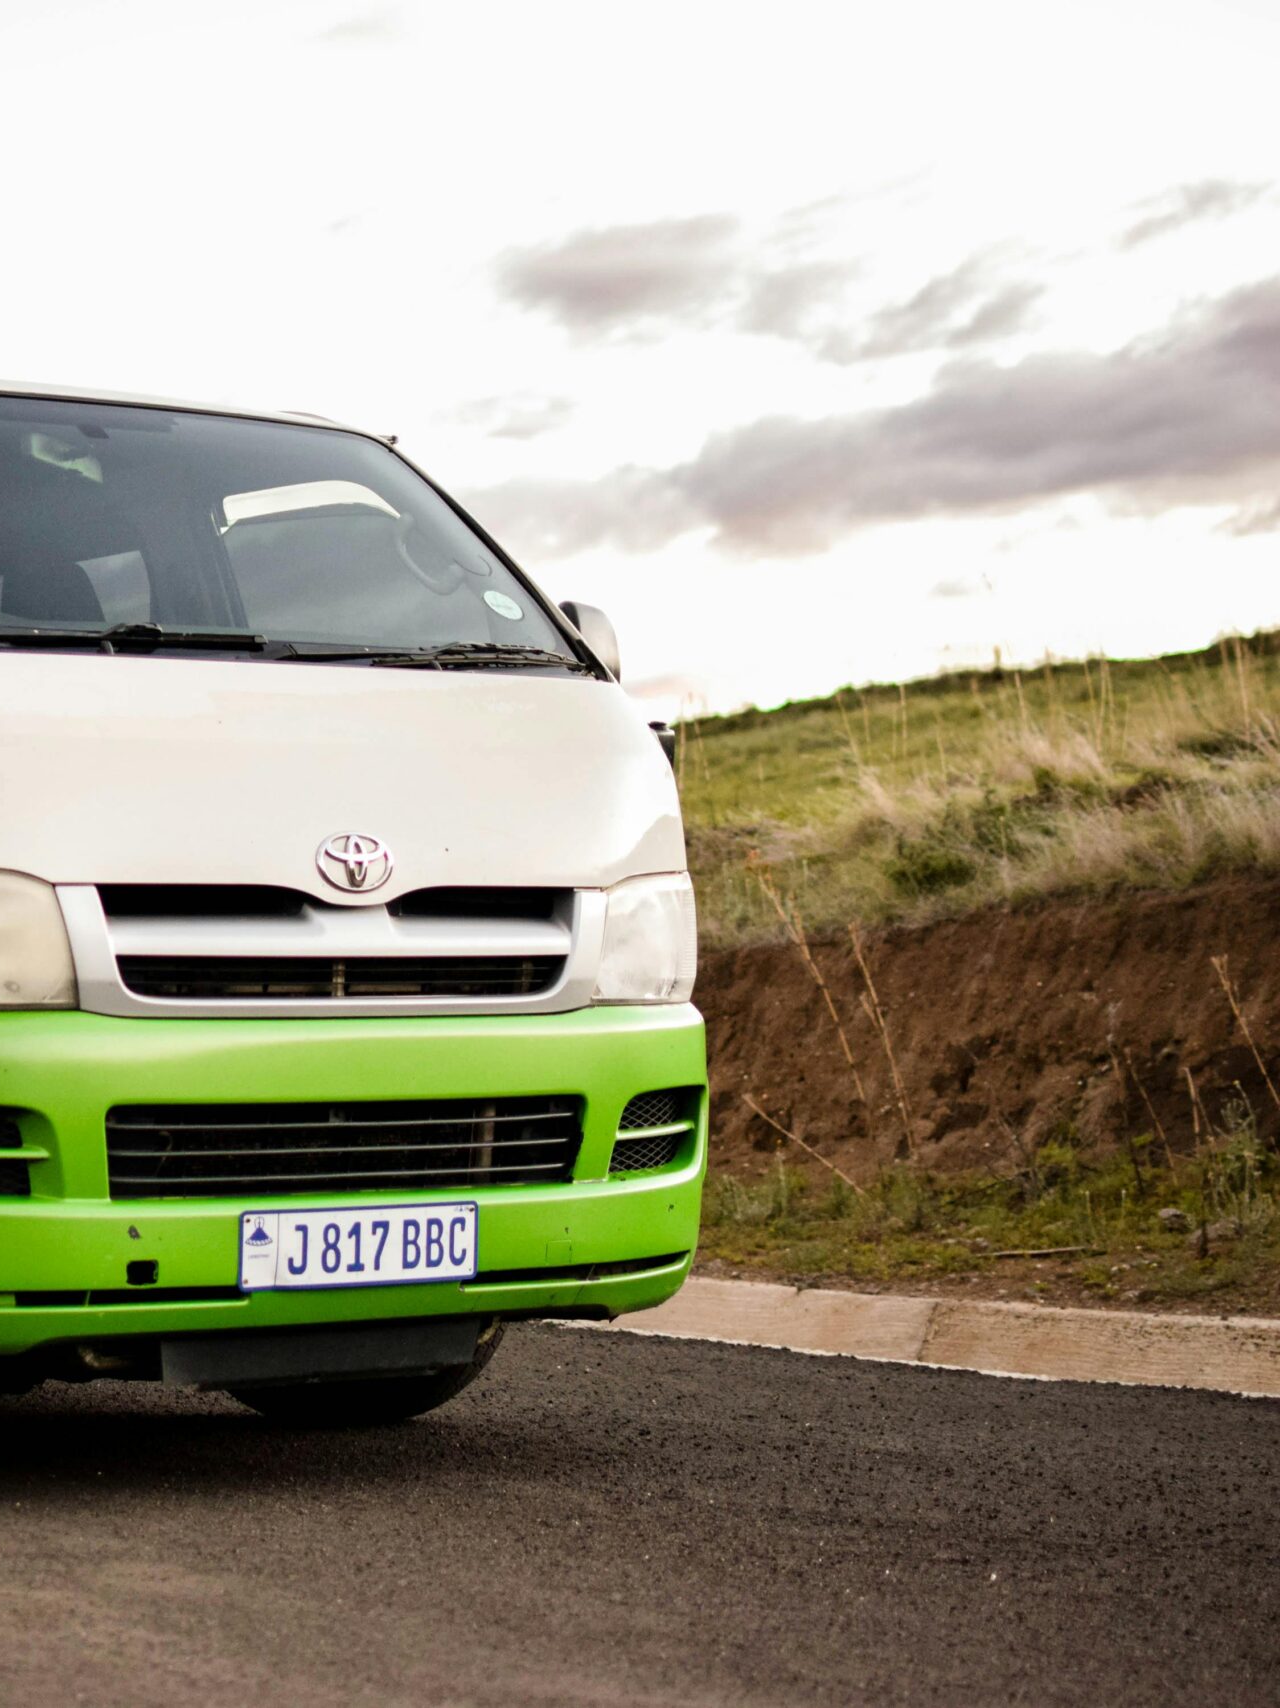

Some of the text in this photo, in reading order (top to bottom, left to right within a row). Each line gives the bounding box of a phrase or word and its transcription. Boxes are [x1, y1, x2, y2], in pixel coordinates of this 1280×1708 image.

[287, 1216, 467, 1275] J 817 BBC
